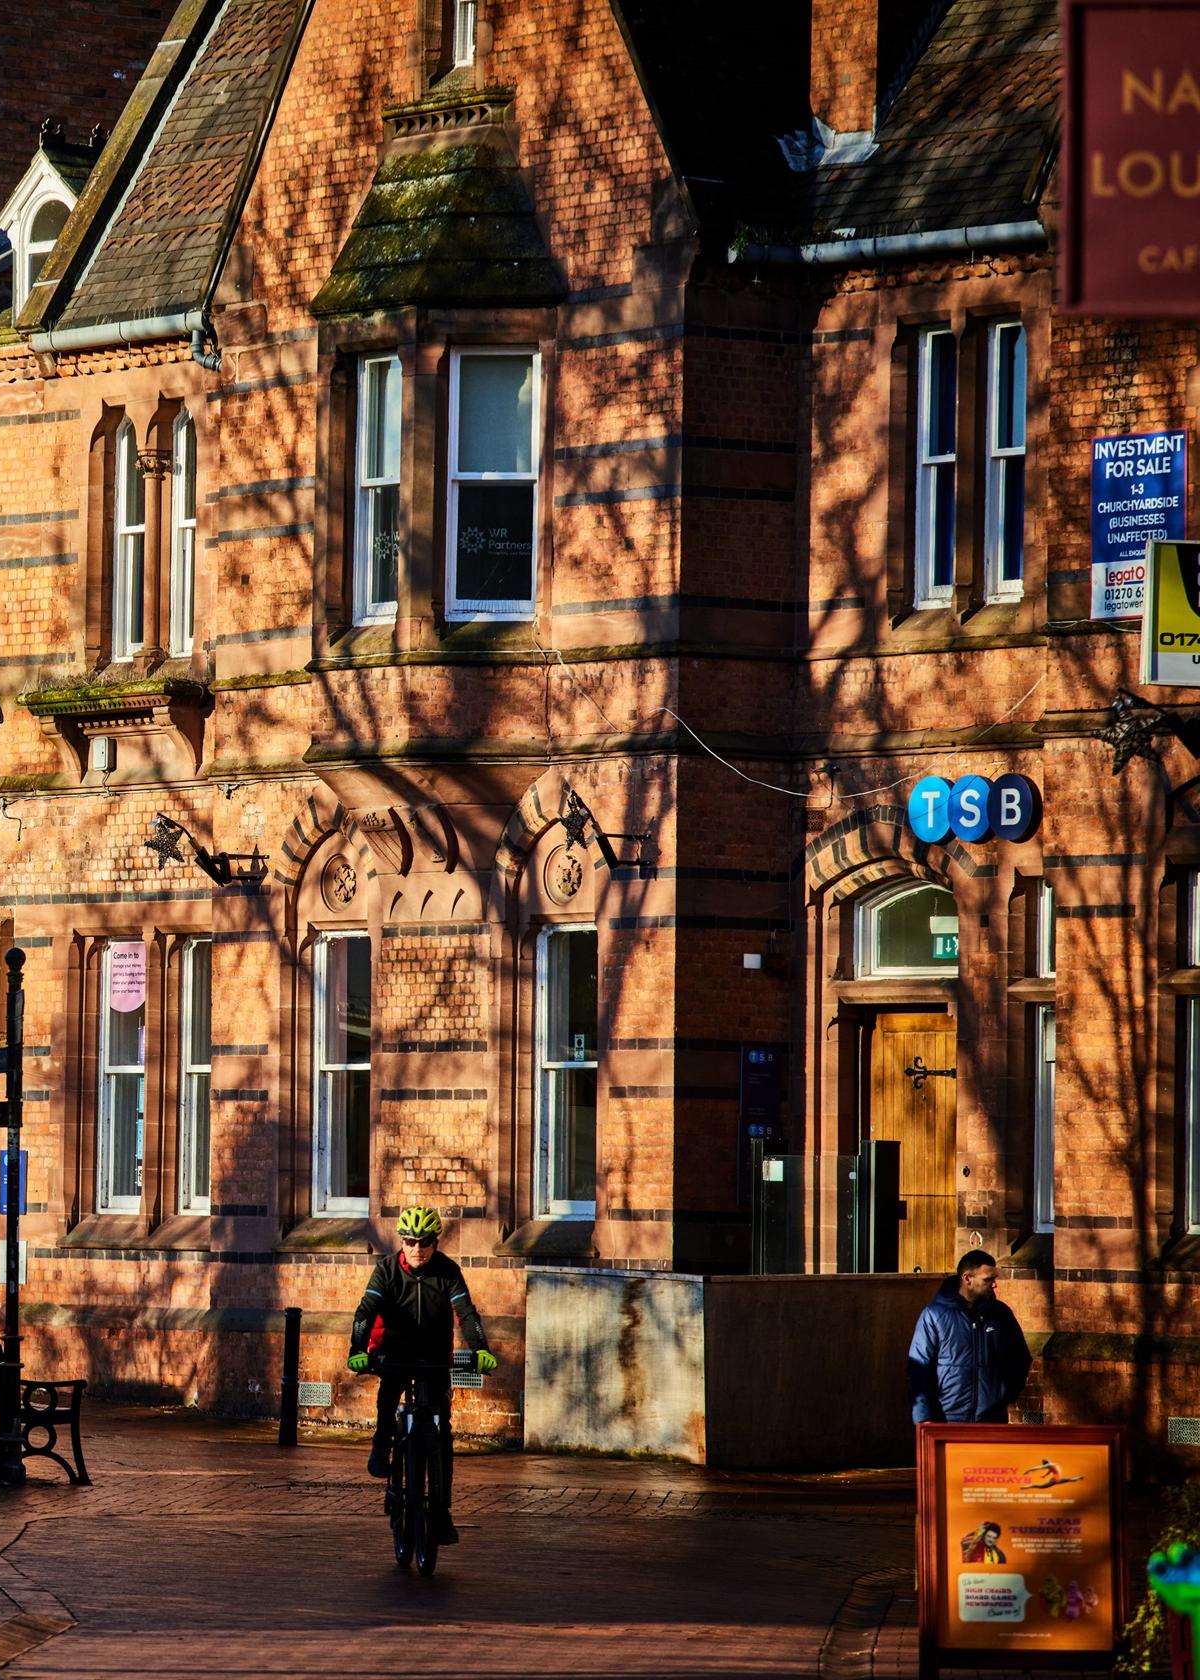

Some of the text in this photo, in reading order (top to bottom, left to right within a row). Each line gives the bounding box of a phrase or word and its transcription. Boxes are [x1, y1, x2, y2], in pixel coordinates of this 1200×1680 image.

[1122, 68, 1200, 114] NA
[1095, 435, 1184, 460] INVESTMENT
[1105, 457, 1171, 479] FOR SALE
[1130, 483, 1144, 495] 1-3
[1097, 496, 1179, 513] CHURCHYARDSIDE
[1109, 513, 1165, 529] (BUSINESSES
[489, 528, 508, 538] WR
[1107, 529, 1168, 544] UNAFFECTED)
[488, 540, 532, 550] Partners
[1104, 588, 1132, 600] 01270
[1160, 632, 1200, 646] 017
[921, 788, 1022, 828] TSB
[113, 952, 127, 960] Come
[963, 1476, 1032, 1485] MONDAYS
[1009, 1526, 1081, 1534] TUESDAYS
